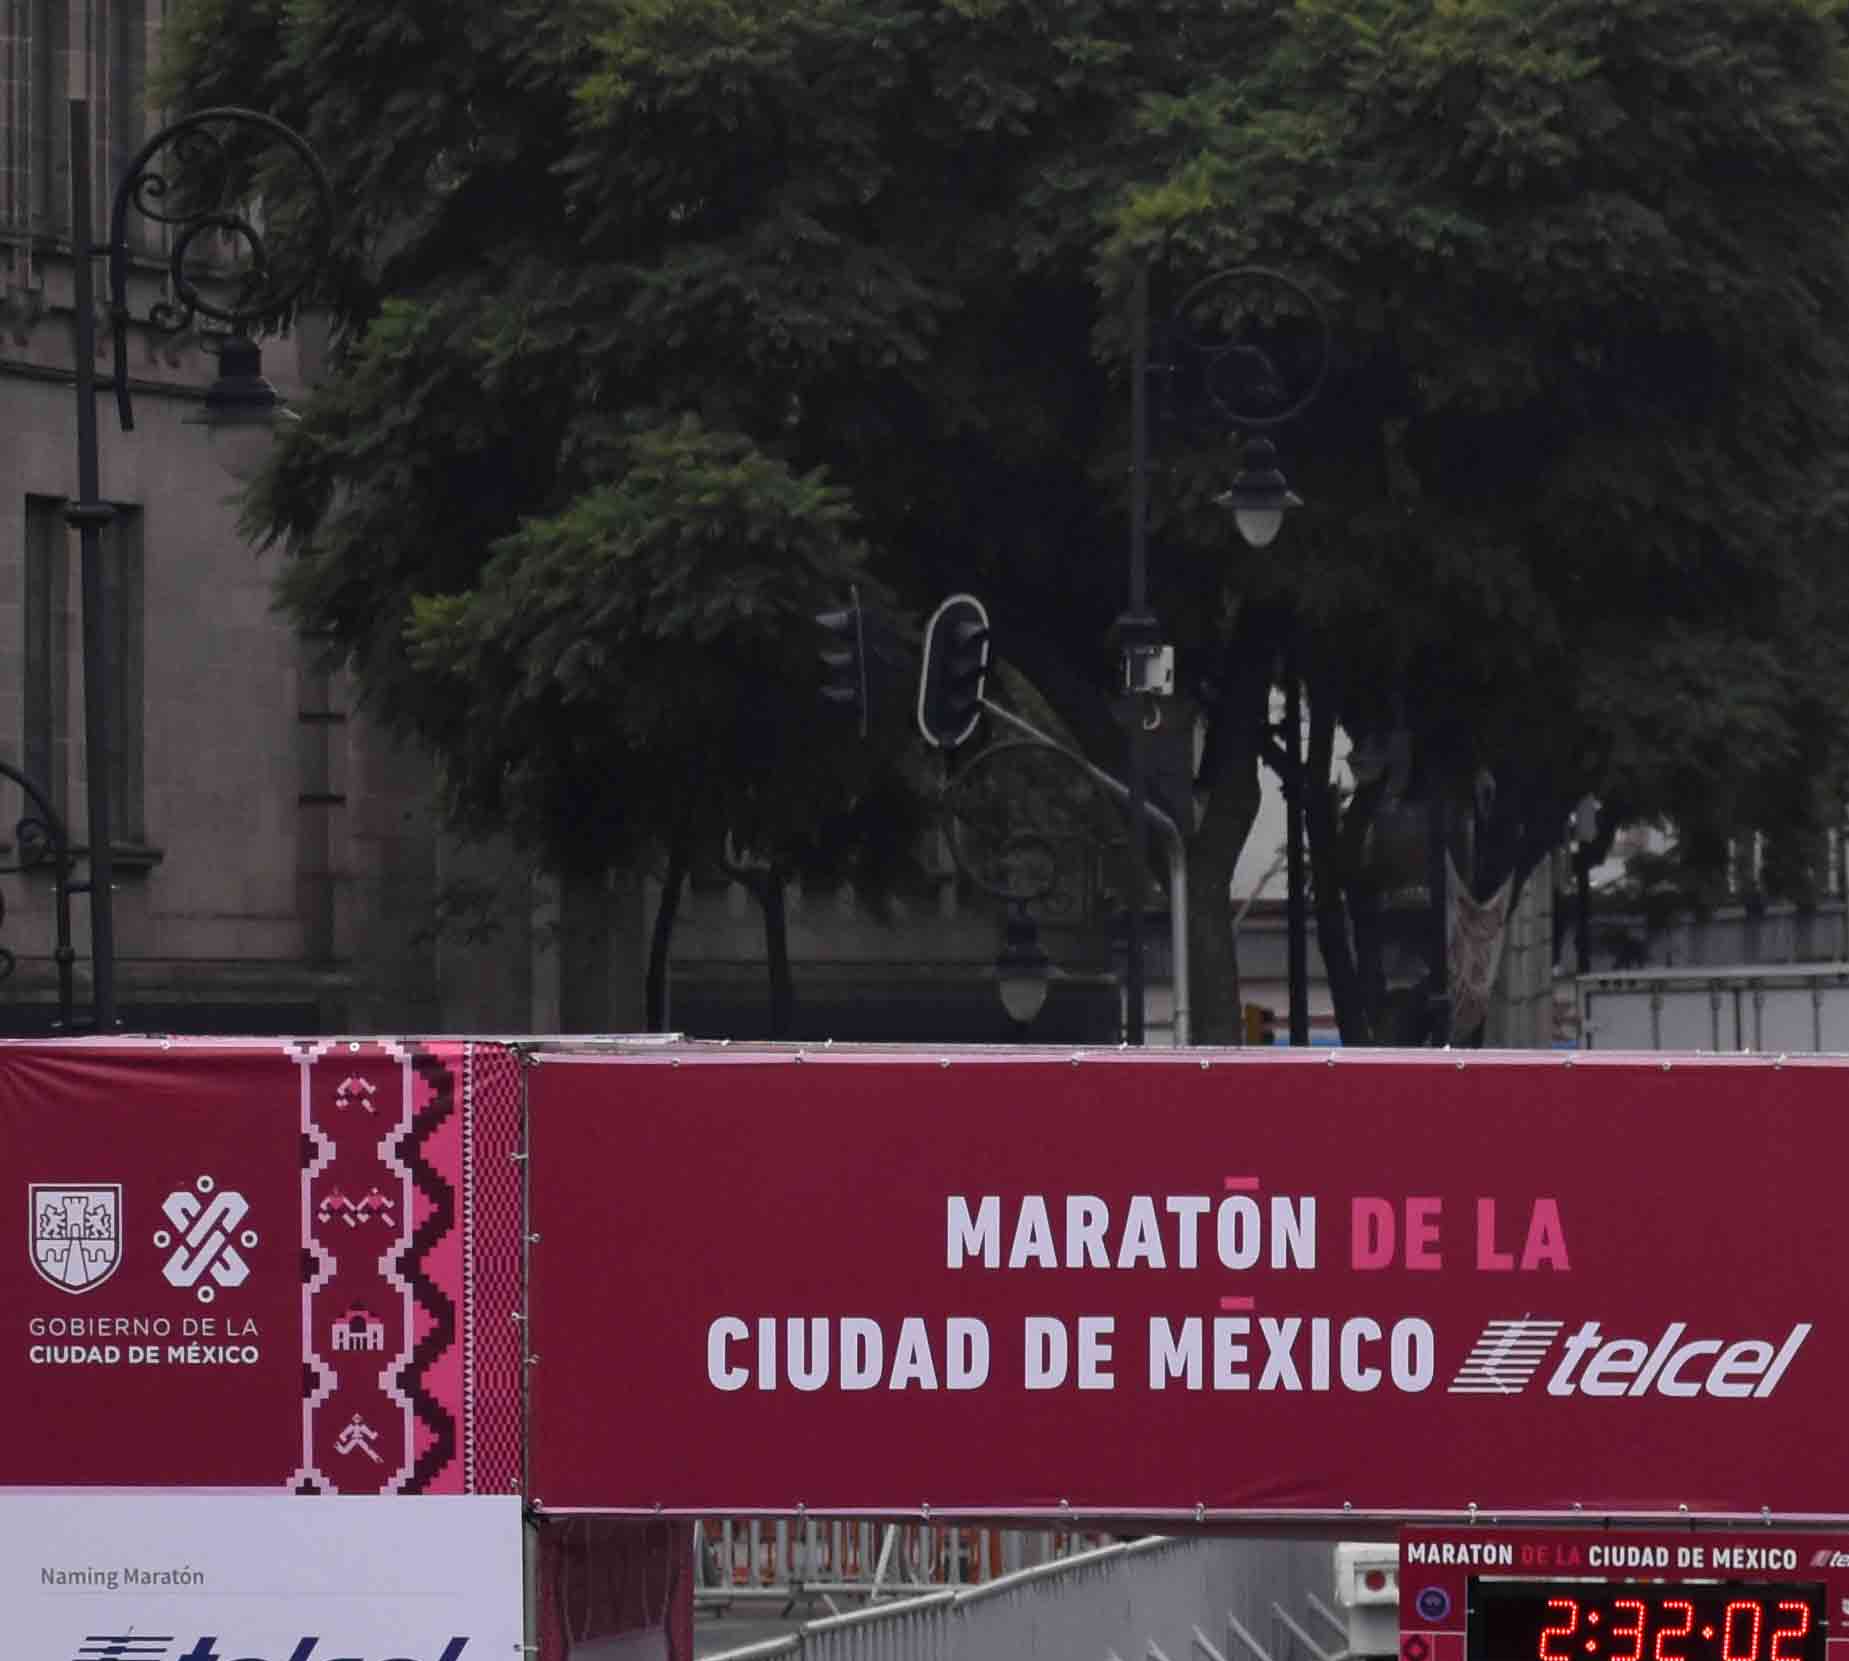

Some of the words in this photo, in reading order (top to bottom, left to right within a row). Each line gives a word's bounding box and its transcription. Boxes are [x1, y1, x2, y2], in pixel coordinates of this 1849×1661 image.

[1351, 1197, 1442, 1271] DE
[1475, 1197, 1571, 1271] LA
[29, 1318, 170, 1337] GOBIERNO
[182, 1318, 212, 1336] DE
[226, 1318, 258, 1336] LA
[29, 1345, 120, 1364] CIUDAD
[128, 1345, 160, 1364] DE
[167, 1338, 259, 1364] MÉXICO
[707, 1316, 990, 1391] CIUDAD
[1024, 1316, 1115, 1391] DE
[1547, 1321, 1812, 1398] telcel
[1588, 1545, 1669, 1567] CIUDAD
[1677, 1546, 1704, 1567] DE
[41, 1567, 118, 1589] Naming
[124, 1565, 205, 1586] Maratón
